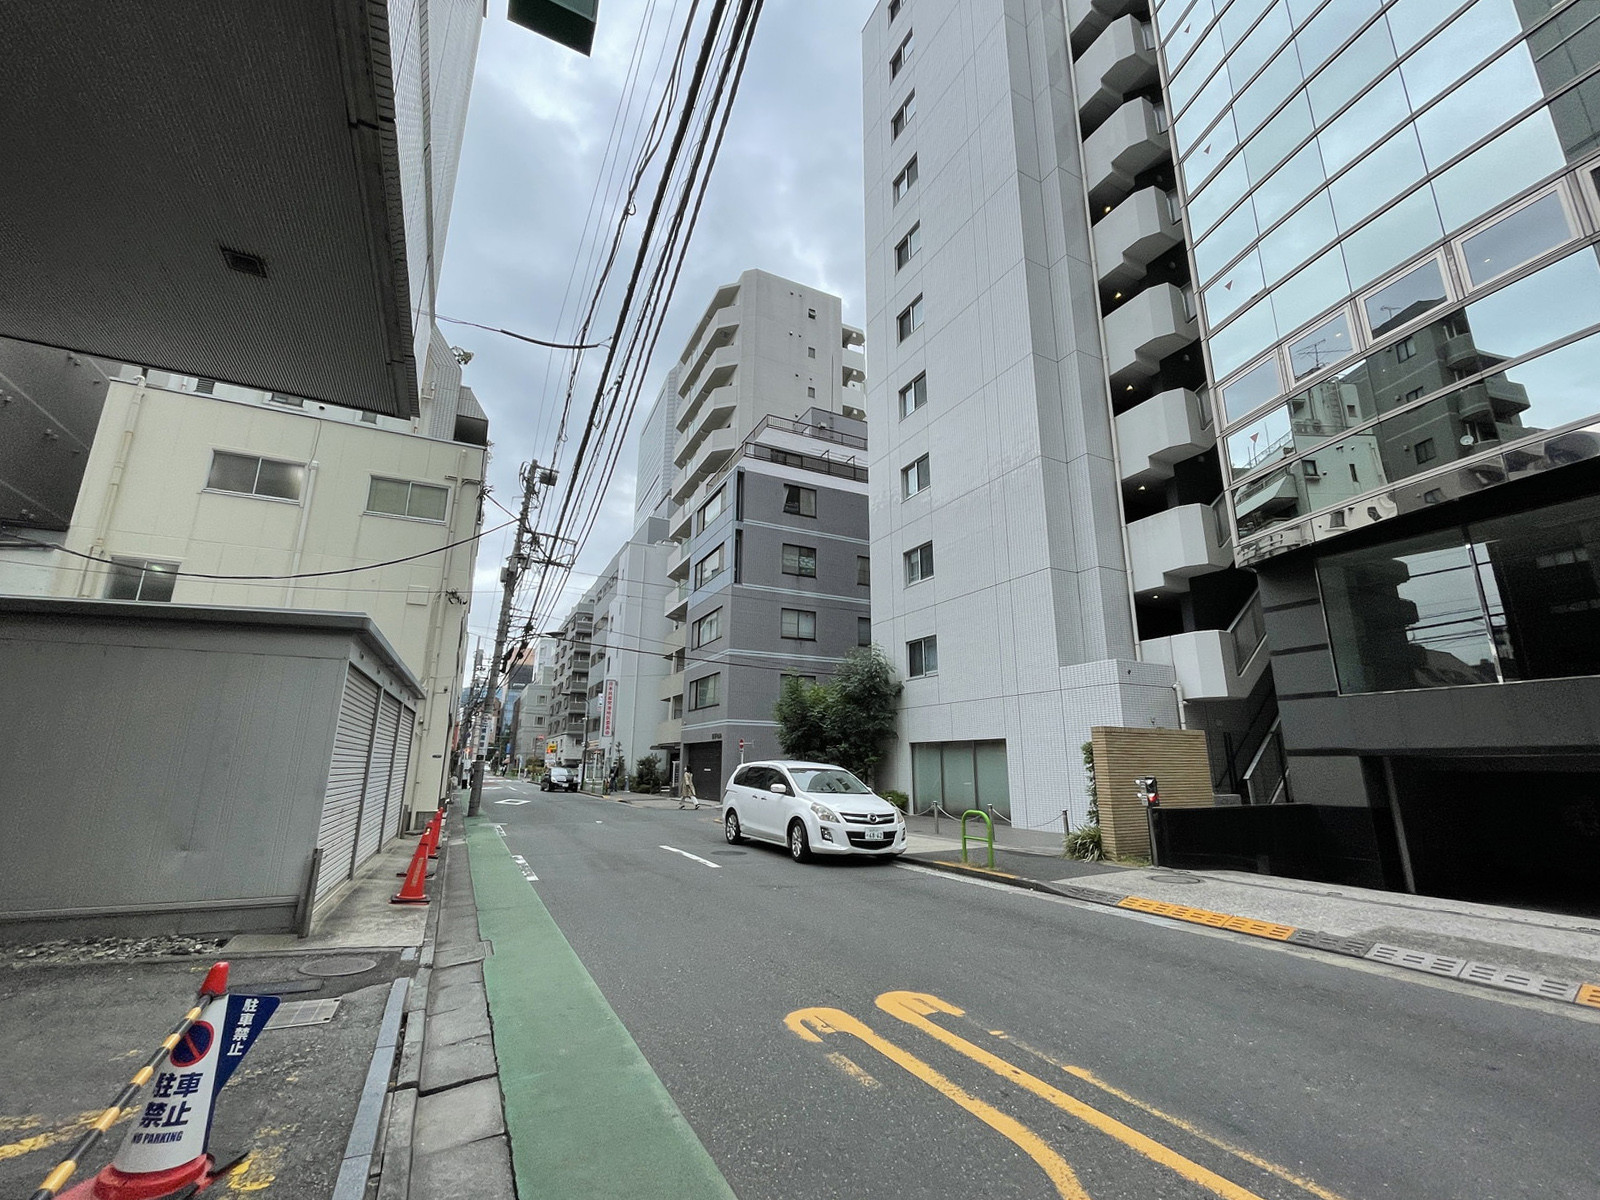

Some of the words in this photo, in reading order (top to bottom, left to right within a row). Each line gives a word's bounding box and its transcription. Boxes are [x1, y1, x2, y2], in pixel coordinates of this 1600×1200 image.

[227, 998, 260, 1056] 駐車禁止
[152, 1072, 204, 1098] 駐車
[138, 1101, 192, 1128] 禁止
[131, 1132, 143, 1145] NO
[143, 1131, 184, 1144] PARKING
